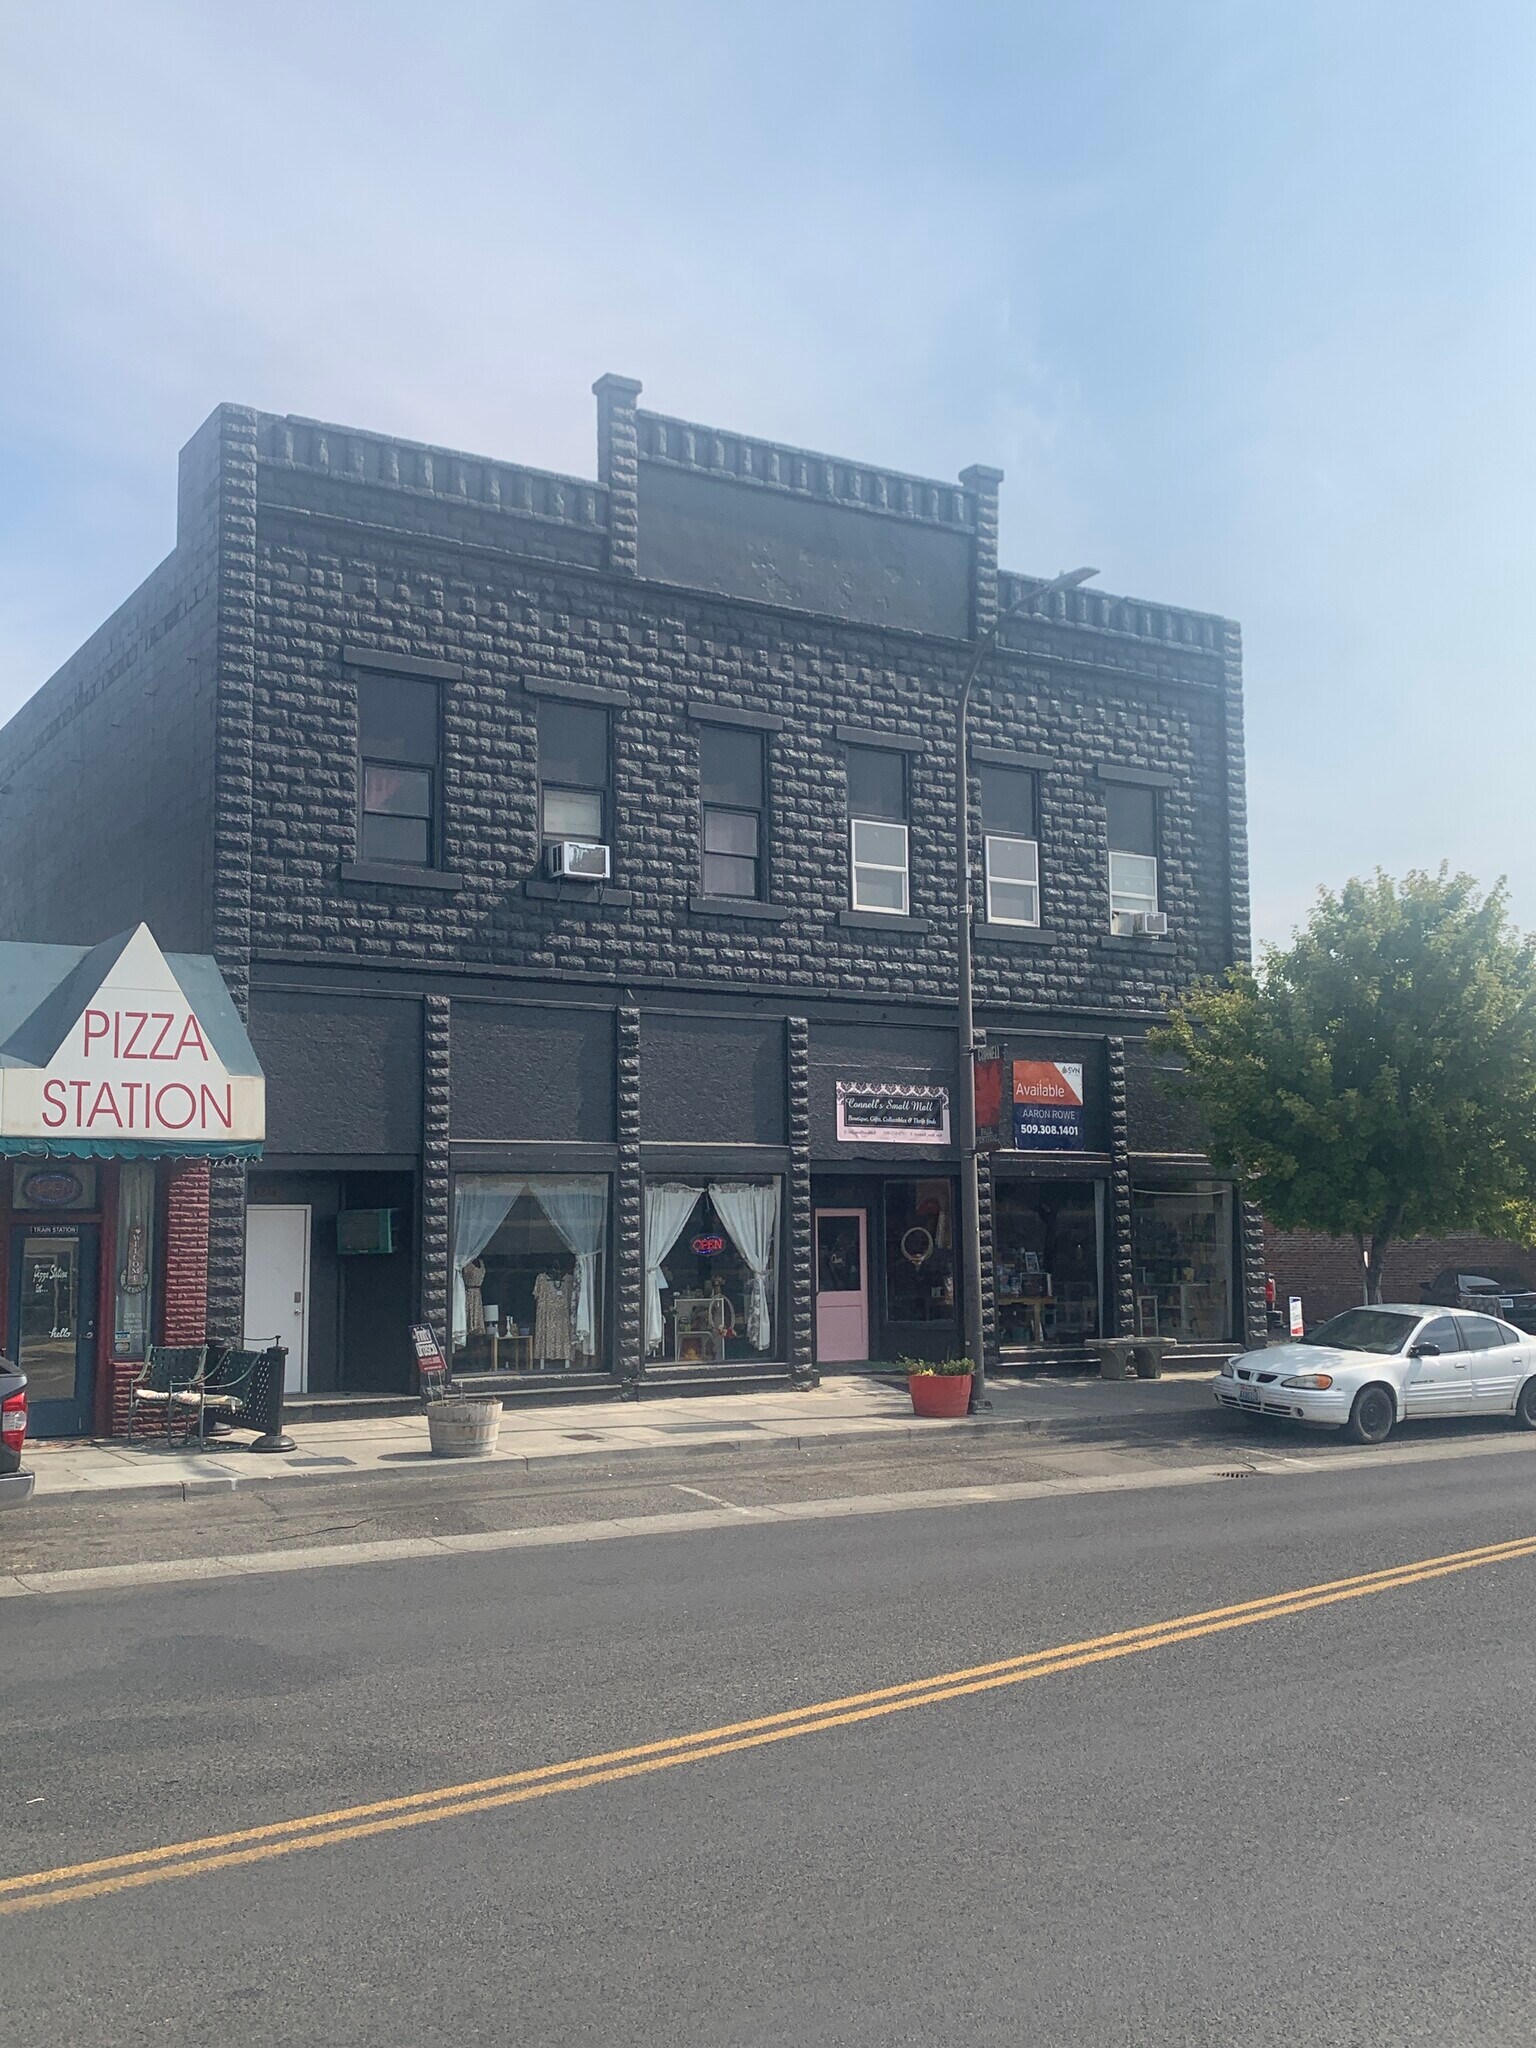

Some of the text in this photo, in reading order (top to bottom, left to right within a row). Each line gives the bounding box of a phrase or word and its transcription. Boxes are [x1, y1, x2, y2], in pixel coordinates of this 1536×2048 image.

[84, 1009, 209, 1061] PIZZA
[1068, 1066, 1081, 1074] SVN
[1016, 1079, 1065, 1098] Available
[42, 1079, 233, 1129] STATION
[846, 1097, 934, 1112] Connell's Small Mall
[1023, 1109, 1076, 1120] AARON ROWE
[1021, 1124, 1079, 1136] 509.308.1401
[692, 1238, 723, 1251] OPEN
[48, 1326, 72, 1338] hello
